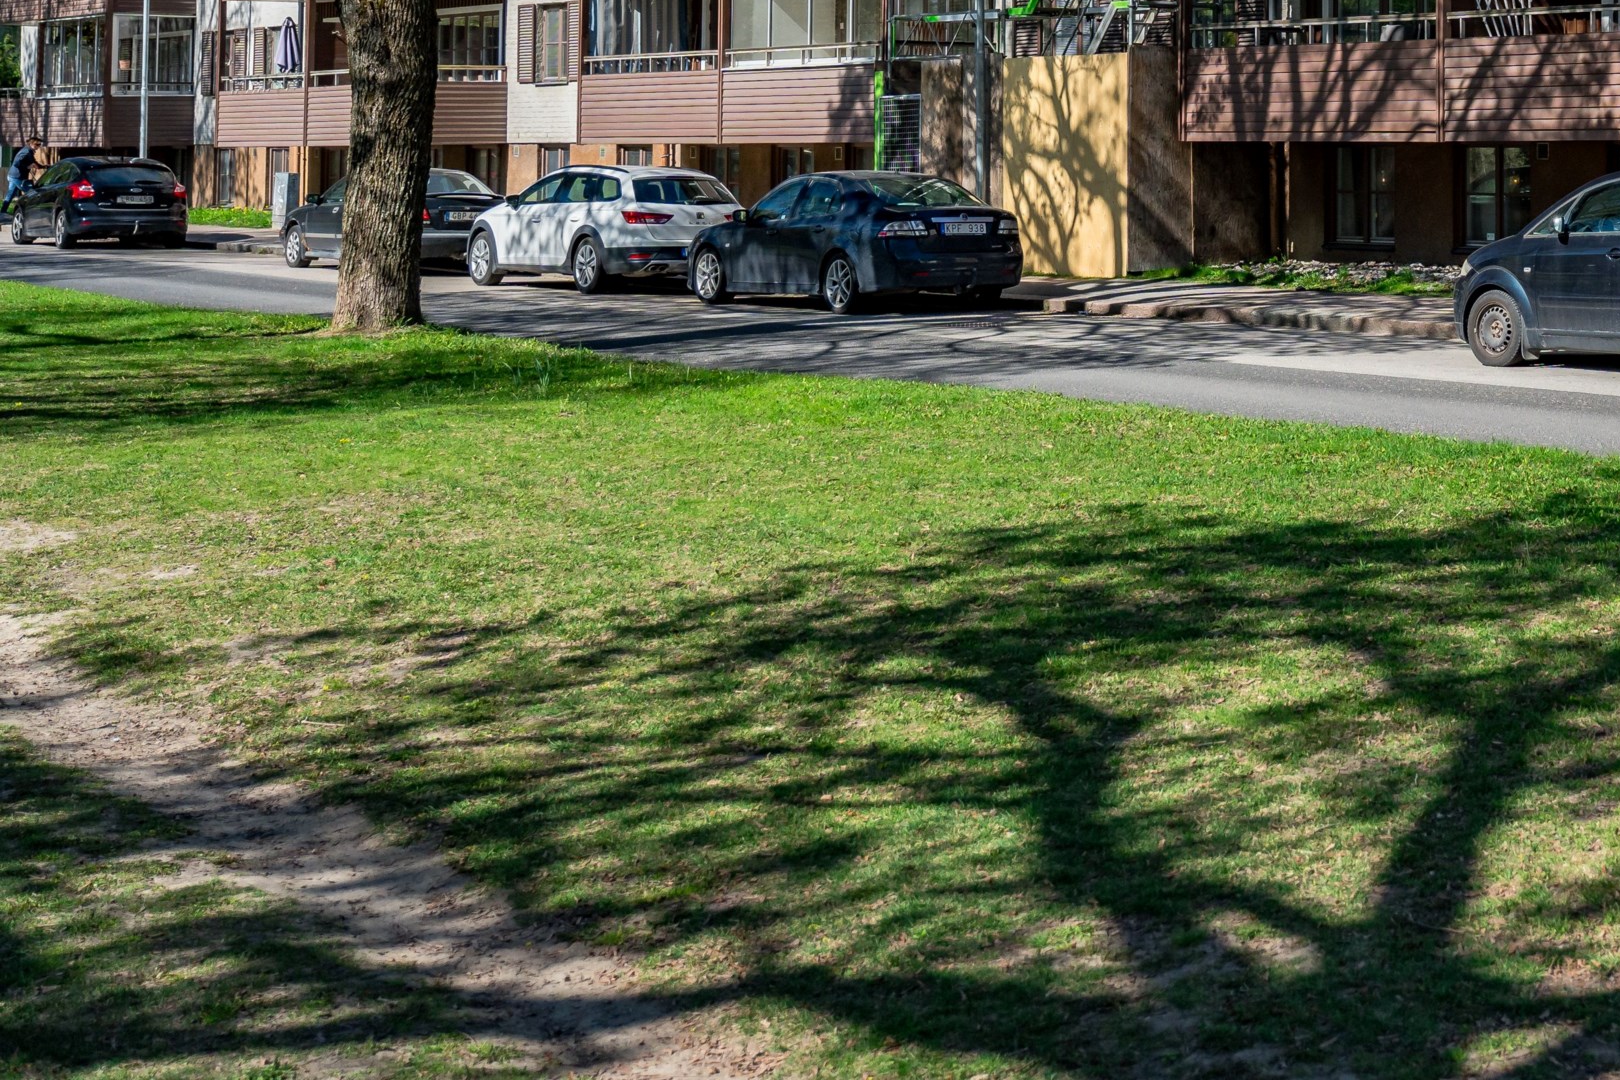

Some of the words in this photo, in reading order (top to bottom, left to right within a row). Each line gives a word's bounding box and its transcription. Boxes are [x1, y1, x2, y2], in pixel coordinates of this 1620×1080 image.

[452, 212, 467, 220] GBP
[945, 224, 961, 233] KPF
[968, 224, 985, 233] 938
